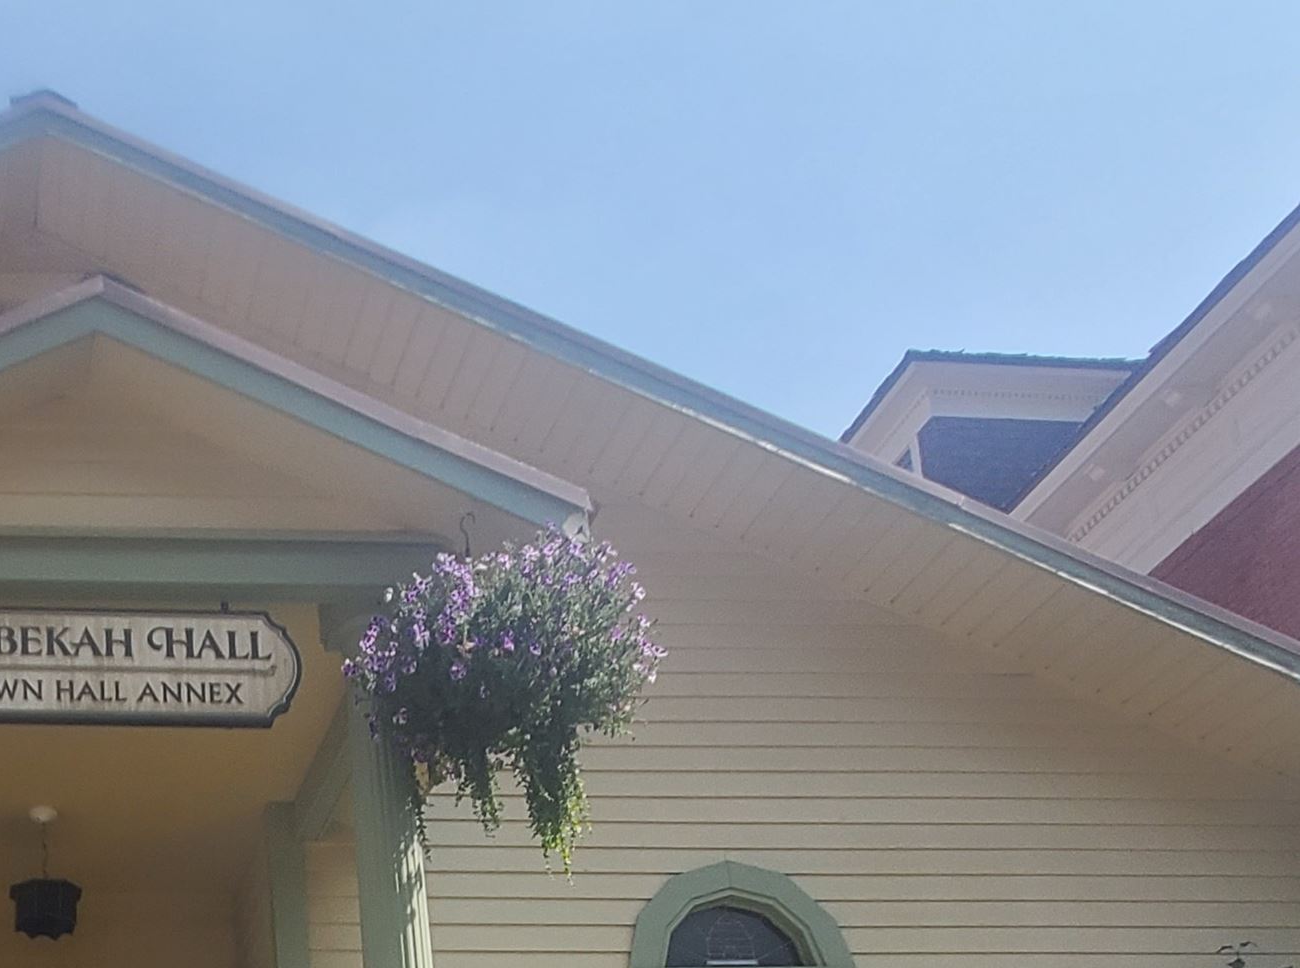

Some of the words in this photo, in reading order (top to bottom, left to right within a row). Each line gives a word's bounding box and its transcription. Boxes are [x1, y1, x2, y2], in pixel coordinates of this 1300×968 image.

[147, 625, 272, 661] HALL
[56, 679, 127, 703] HALL
[140, 681, 244, 704] ANNEX
